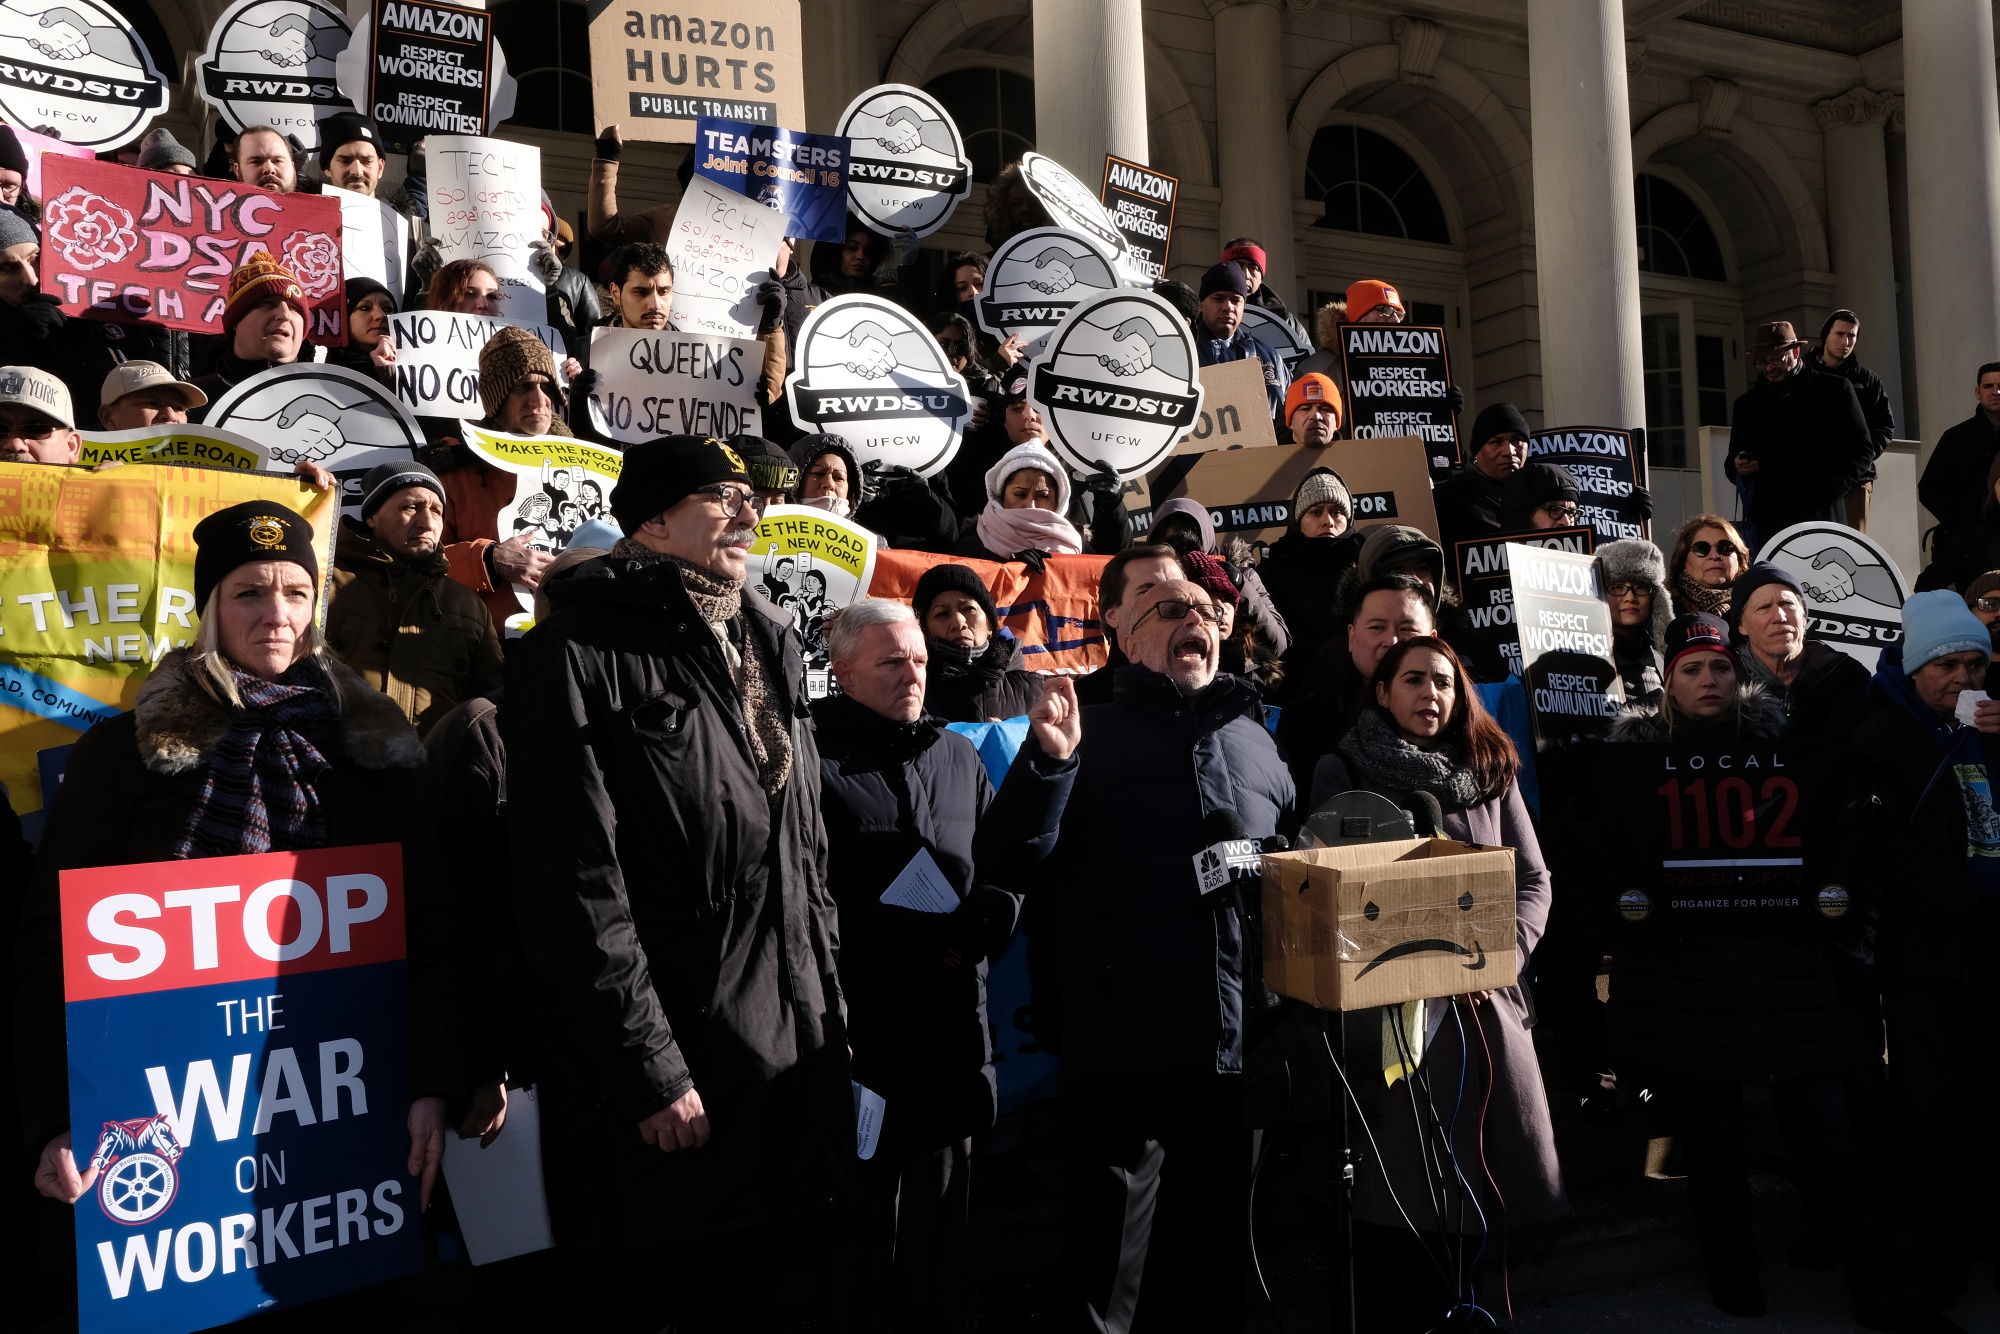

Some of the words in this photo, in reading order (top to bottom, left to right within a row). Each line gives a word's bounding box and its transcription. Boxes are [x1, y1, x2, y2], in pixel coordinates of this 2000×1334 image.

[382, 2, 484, 41] AMAZON
[624, 10, 775, 51] amazon
[400, 44, 464, 66] RESPECT
[0, 63, 144, 100] RWDSU
[378, 54, 483, 88] WORKERS!
[626, 48, 776, 93] HURTS
[224, 79, 335, 99] RWDS
[398, 92, 462, 114] RESPECT
[37, 107, 98, 124] UFCW
[374, 102, 482, 135] COMMUNITIES!
[641, 97, 698, 115] PUBLIC
[703, 101, 767, 121] TRANSIT
[704, 130, 841, 168] TEAMSTERS
[440, 150, 516, 183] TECH
[703, 154, 749, 175] Joint
[753, 161, 815, 184] Council
[820, 171, 839, 187] 16
[849, 163, 955, 186] RWDSU
[1108, 163, 1173, 202] AMAZON
[140, 179, 283, 236] NYC
[447, 206, 515, 230] against
[703, 190, 758, 238] TECH
[881, 199, 923, 210] UFCW
[1117, 200, 1158, 221] RESPECT
[1103, 207, 1168, 241] WORKERS!
[56, 274, 185, 320] TECH
[1000, 308, 1071, 321] RWD
[393, 315, 436, 349] NO
[1349, 331, 1440, 354] AMAZON
[630, 338, 744, 386] QUEENS
[1369, 367, 1426, 380] RESPECT
[29, 378, 58, 407] YORK
[397, 364, 441, 407] NO
[1351, 380, 1447, 398] WORKERS!
[817, 395, 950, 414] RWDSU
[1052, 384, 1184, 418] RWDSU
[589, 392, 632, 430] NO
[637, 397, 674, 435] SE
[679, 397, 755, 439] VENDE
[1375, 412, 1432, 424] RESPECT
[82, 447, 143, 463] MAKE
[146, 442, 188, 459] THE
[495, 441, 543, 455] MAKE
[544, 444, 577, 454] THE
[866, 436, 921, 447] UFCW
[1091, 431, 1141, 447] UFCW
[1528, 433, 1627, 457] AMAZON
[559, 456, 588, 466] NEW
[594, 460, 620, 475] YOR
[1353, 496, 1387, 514] FOR
[775, 521, 809, 536] THE
[814, 523, 863, 553] ROAD
[788, 538, 820, 550] NEW
[825, 543, 860, 568] YORK
[1520, 561, 1599, 597] AMAZON
[17, 584, 141, 632] THE
[1539, 610, 1588, 631] RESPECT
[1525, 626, 1609, 656] WORKERS!
[1686, 625, 1720, 638] 1102
[1548, 673, 1597, 693] RESPECT
[1534, 689, 1621, 717] COMMUNITIES!
[1665, 754, 1784, 770] LOCAL
[1658, 775, 1803, 850] 1102
[1224, 840, 1263, 856] WOR
[1205, 874, 1224, 890] RADIO
[1664, 872, 1733, 887] RWDSU
[1671, 900, 1730, 909] ORGANIZE
[1734, 899, 1757, 908] FOR
[1760, 898, 1799, 908] POWER
[87, 873, 388, 981] STOP
[217, 995, 286, 1036] THE
[145, 1037, 369, 1148] WAR
[235, 1151, 286, 1193] ON
[97, 1180, 404, 1300] WORKERS
